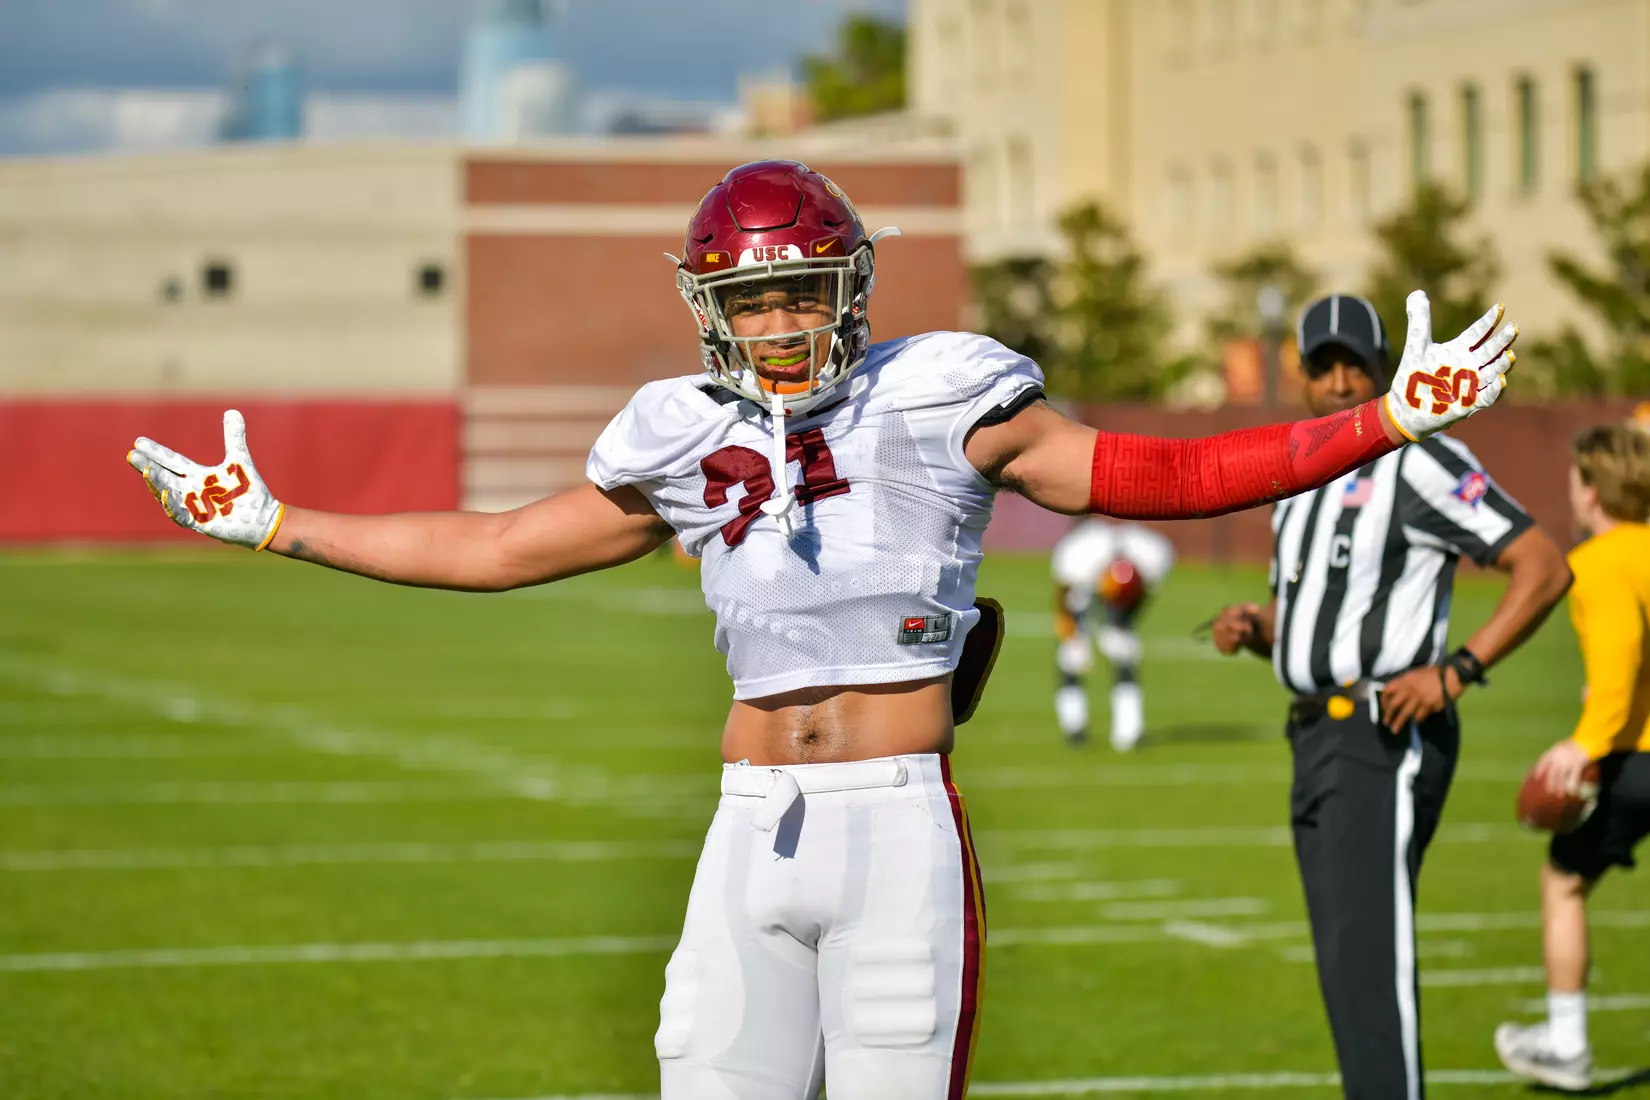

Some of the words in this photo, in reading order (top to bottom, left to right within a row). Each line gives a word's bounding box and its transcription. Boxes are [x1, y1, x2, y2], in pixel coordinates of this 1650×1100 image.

[706, 253, 720, 263] NIKE
[752, 245, 788, 262] USC
[1355, 421, 1363, 437] WE
[184, 462, 251, 524] SC
[1330, 534, 1351, 568] C
[934, 620, 939, 630] L
